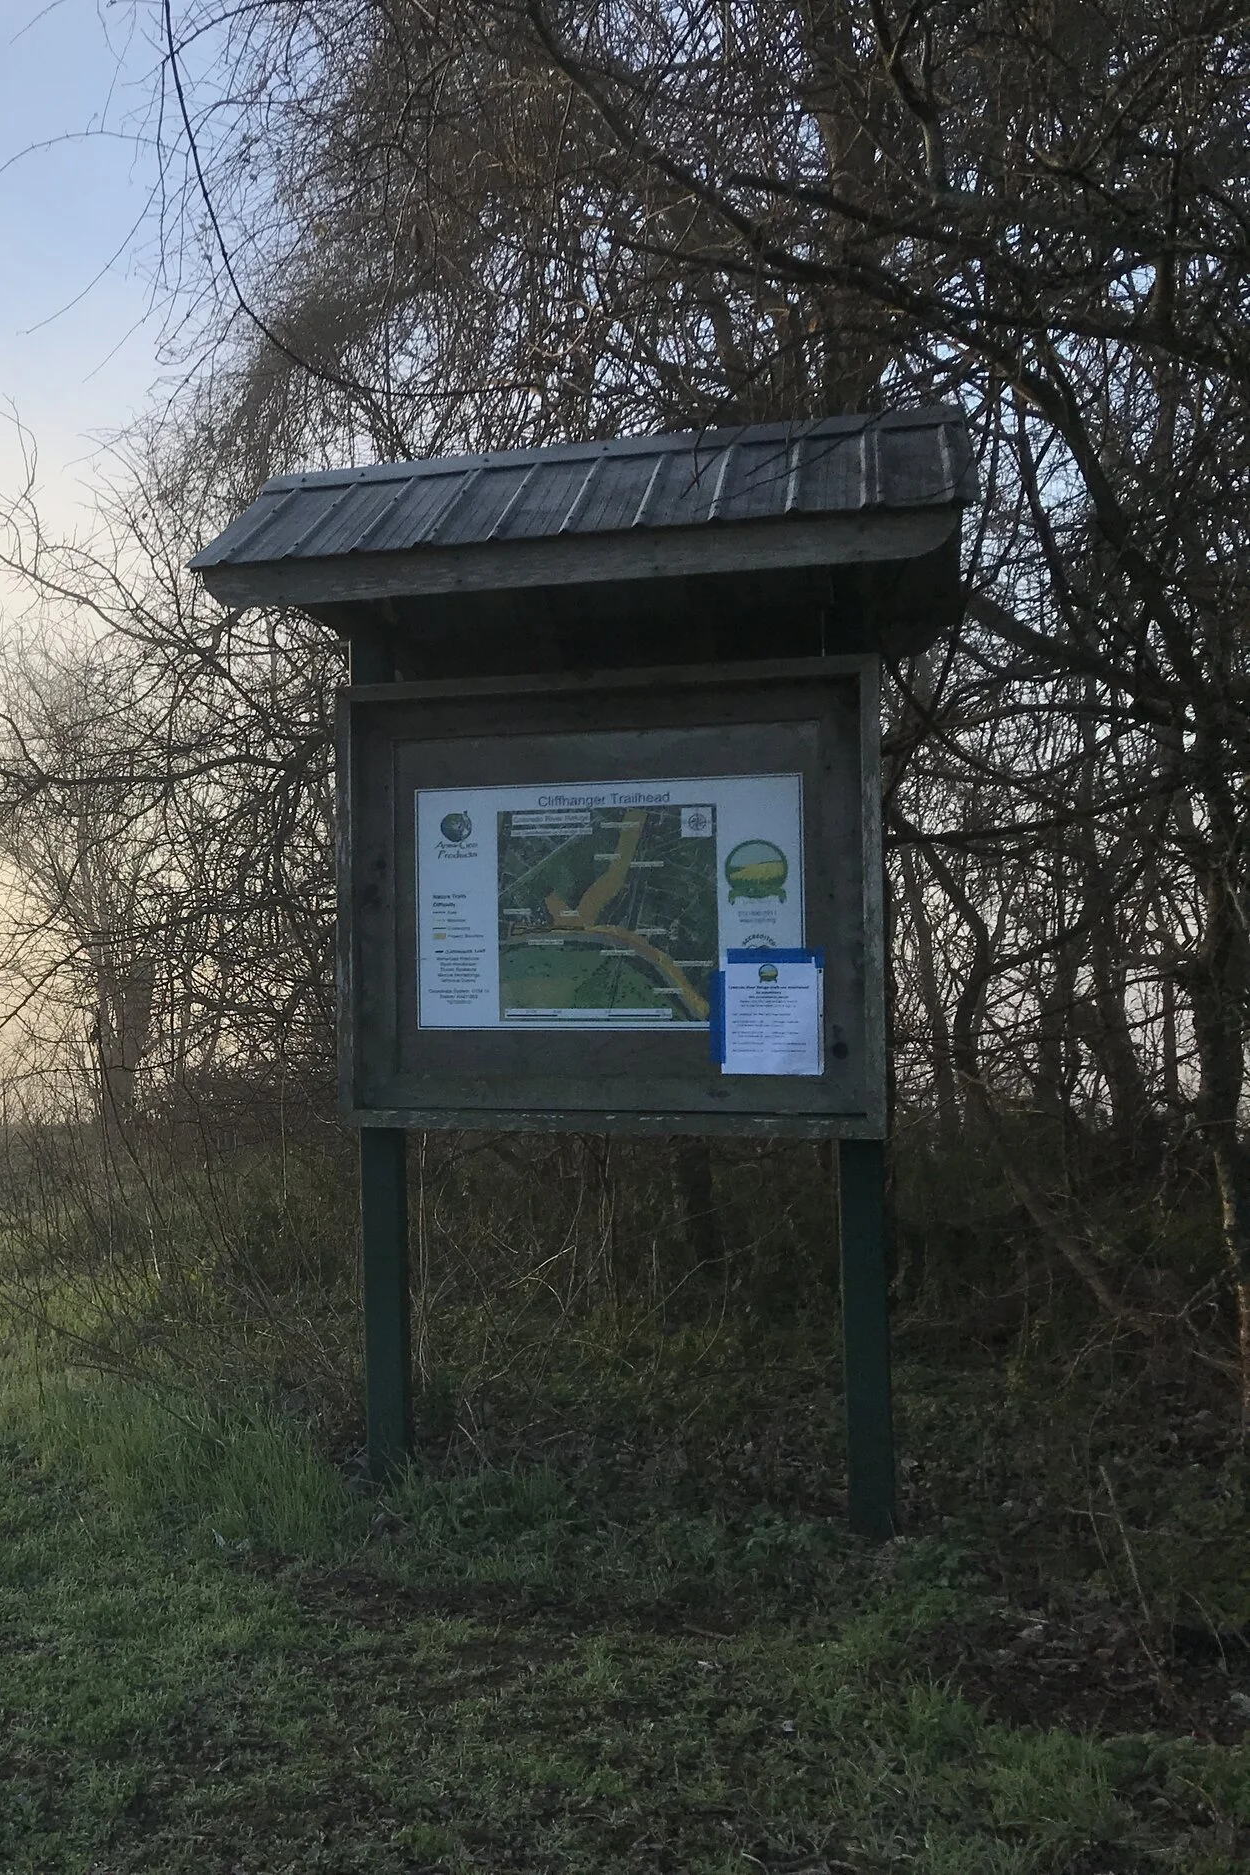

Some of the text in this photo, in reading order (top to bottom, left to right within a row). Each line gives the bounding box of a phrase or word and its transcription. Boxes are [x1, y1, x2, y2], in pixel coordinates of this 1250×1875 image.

[538, 792, 670, 809] Cliffhanger Trailhead
[742, 933, 776, 946] ACCREDITED
